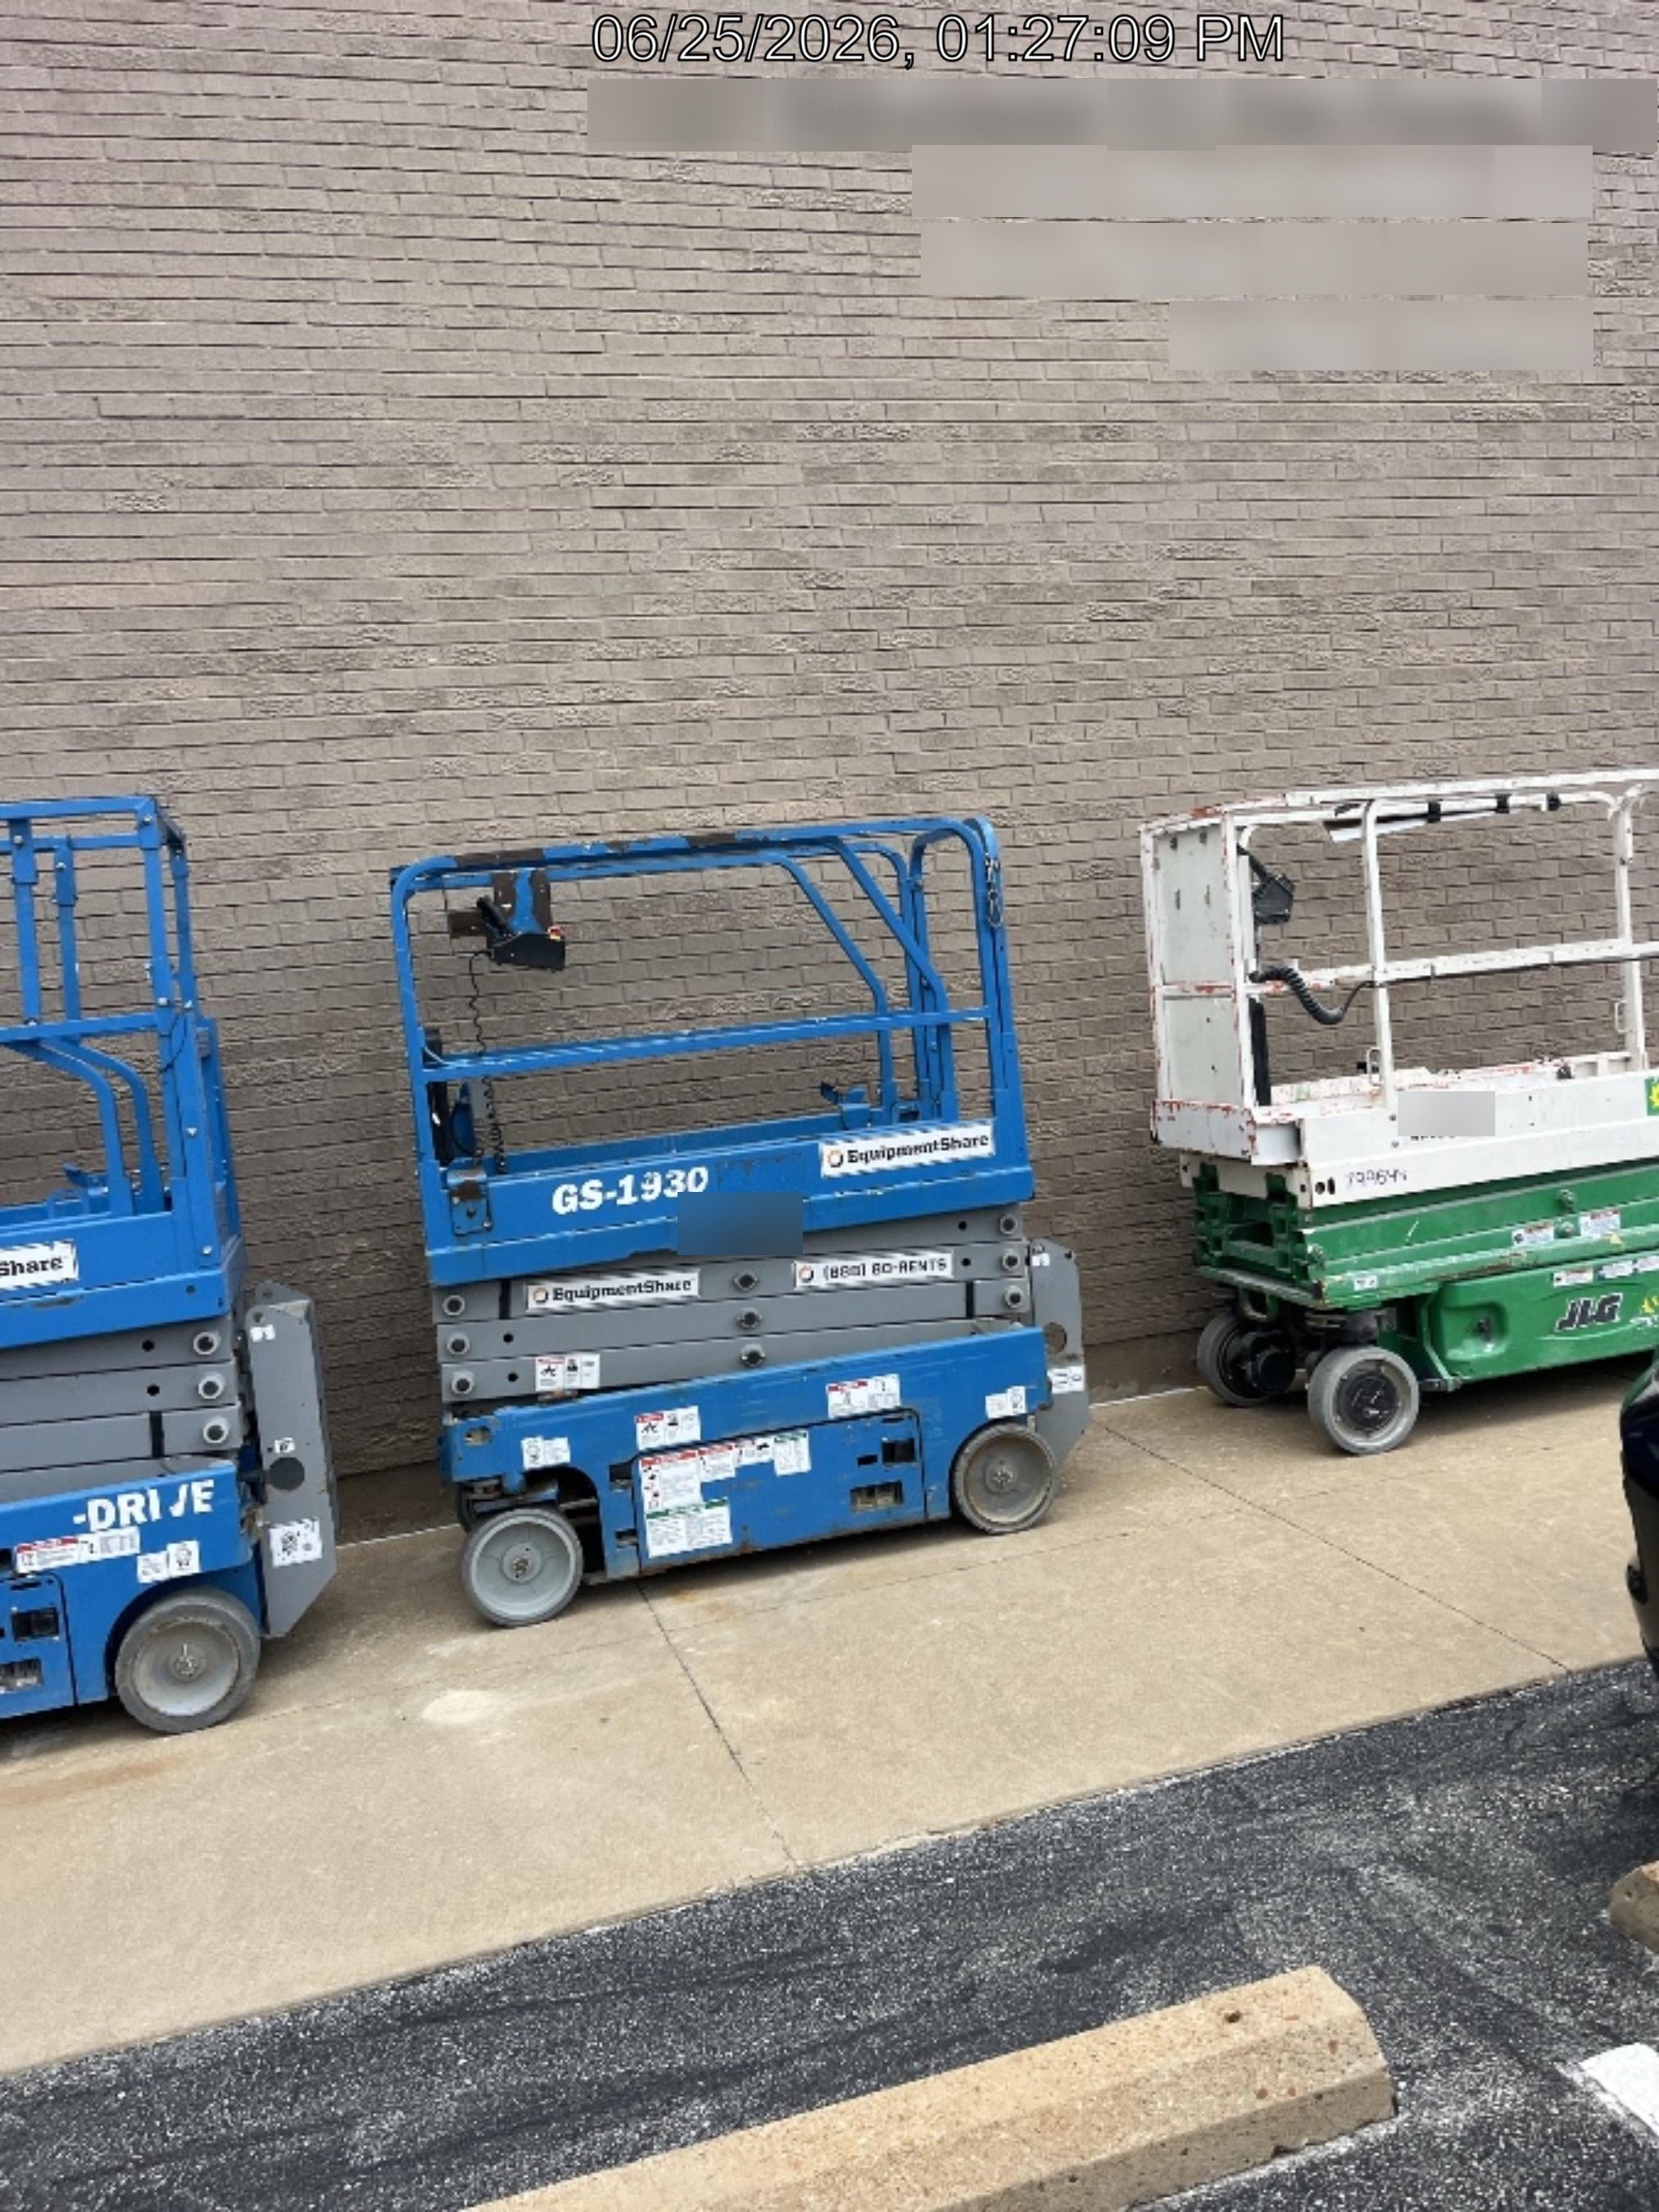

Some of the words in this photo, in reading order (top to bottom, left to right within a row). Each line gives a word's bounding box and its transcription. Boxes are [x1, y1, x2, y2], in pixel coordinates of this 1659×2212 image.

[847, 1135, 989, 1164] EquipmentShare
[551, 1166, 709, 1215] GS-1930
[551, 1280, 692, 1303] EquipmentShare
[1554, 1293, 1623, 1332] JLG
